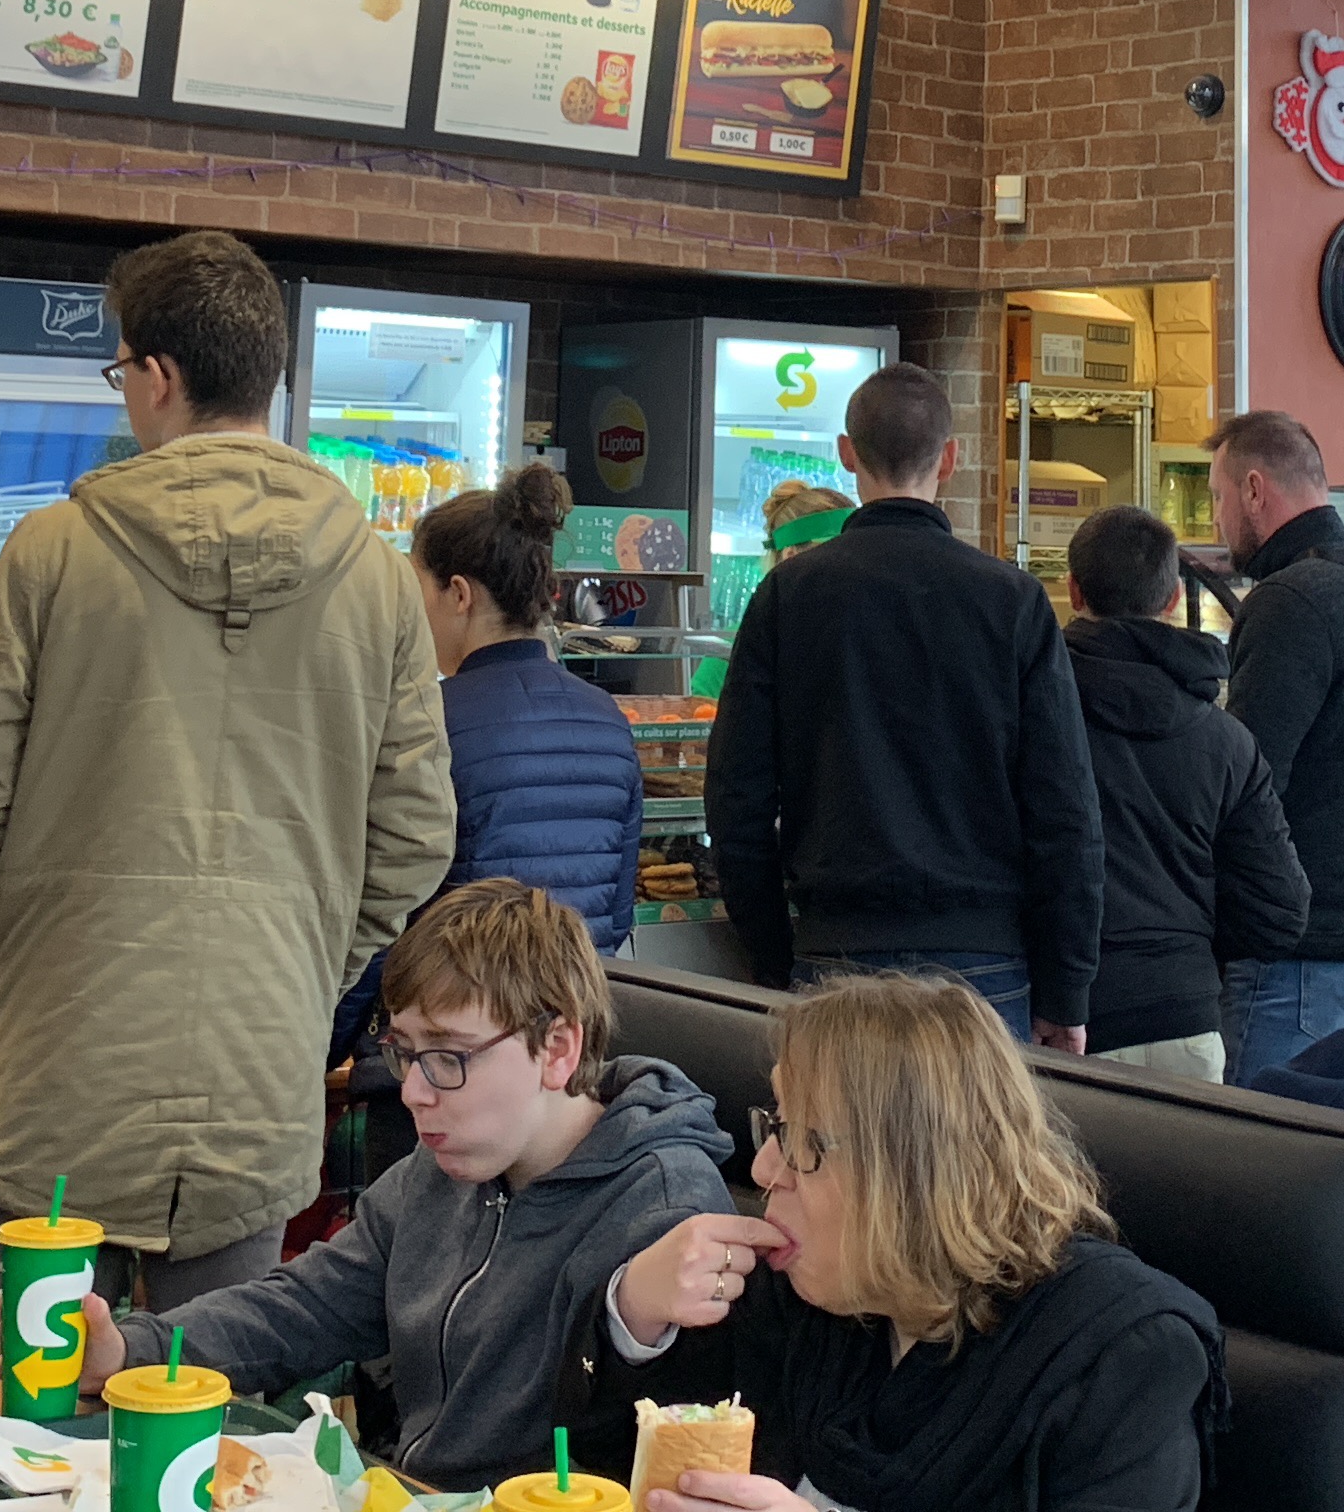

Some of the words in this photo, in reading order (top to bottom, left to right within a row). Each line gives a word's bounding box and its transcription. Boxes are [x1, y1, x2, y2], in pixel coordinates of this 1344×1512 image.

[82, 3, 98, 22] €
[581, 15, 593, 27] et
[596, 17, 646, 36] desserts
[602, 435, 641, 456] Lipton
[679, 727, 701, 738] place
